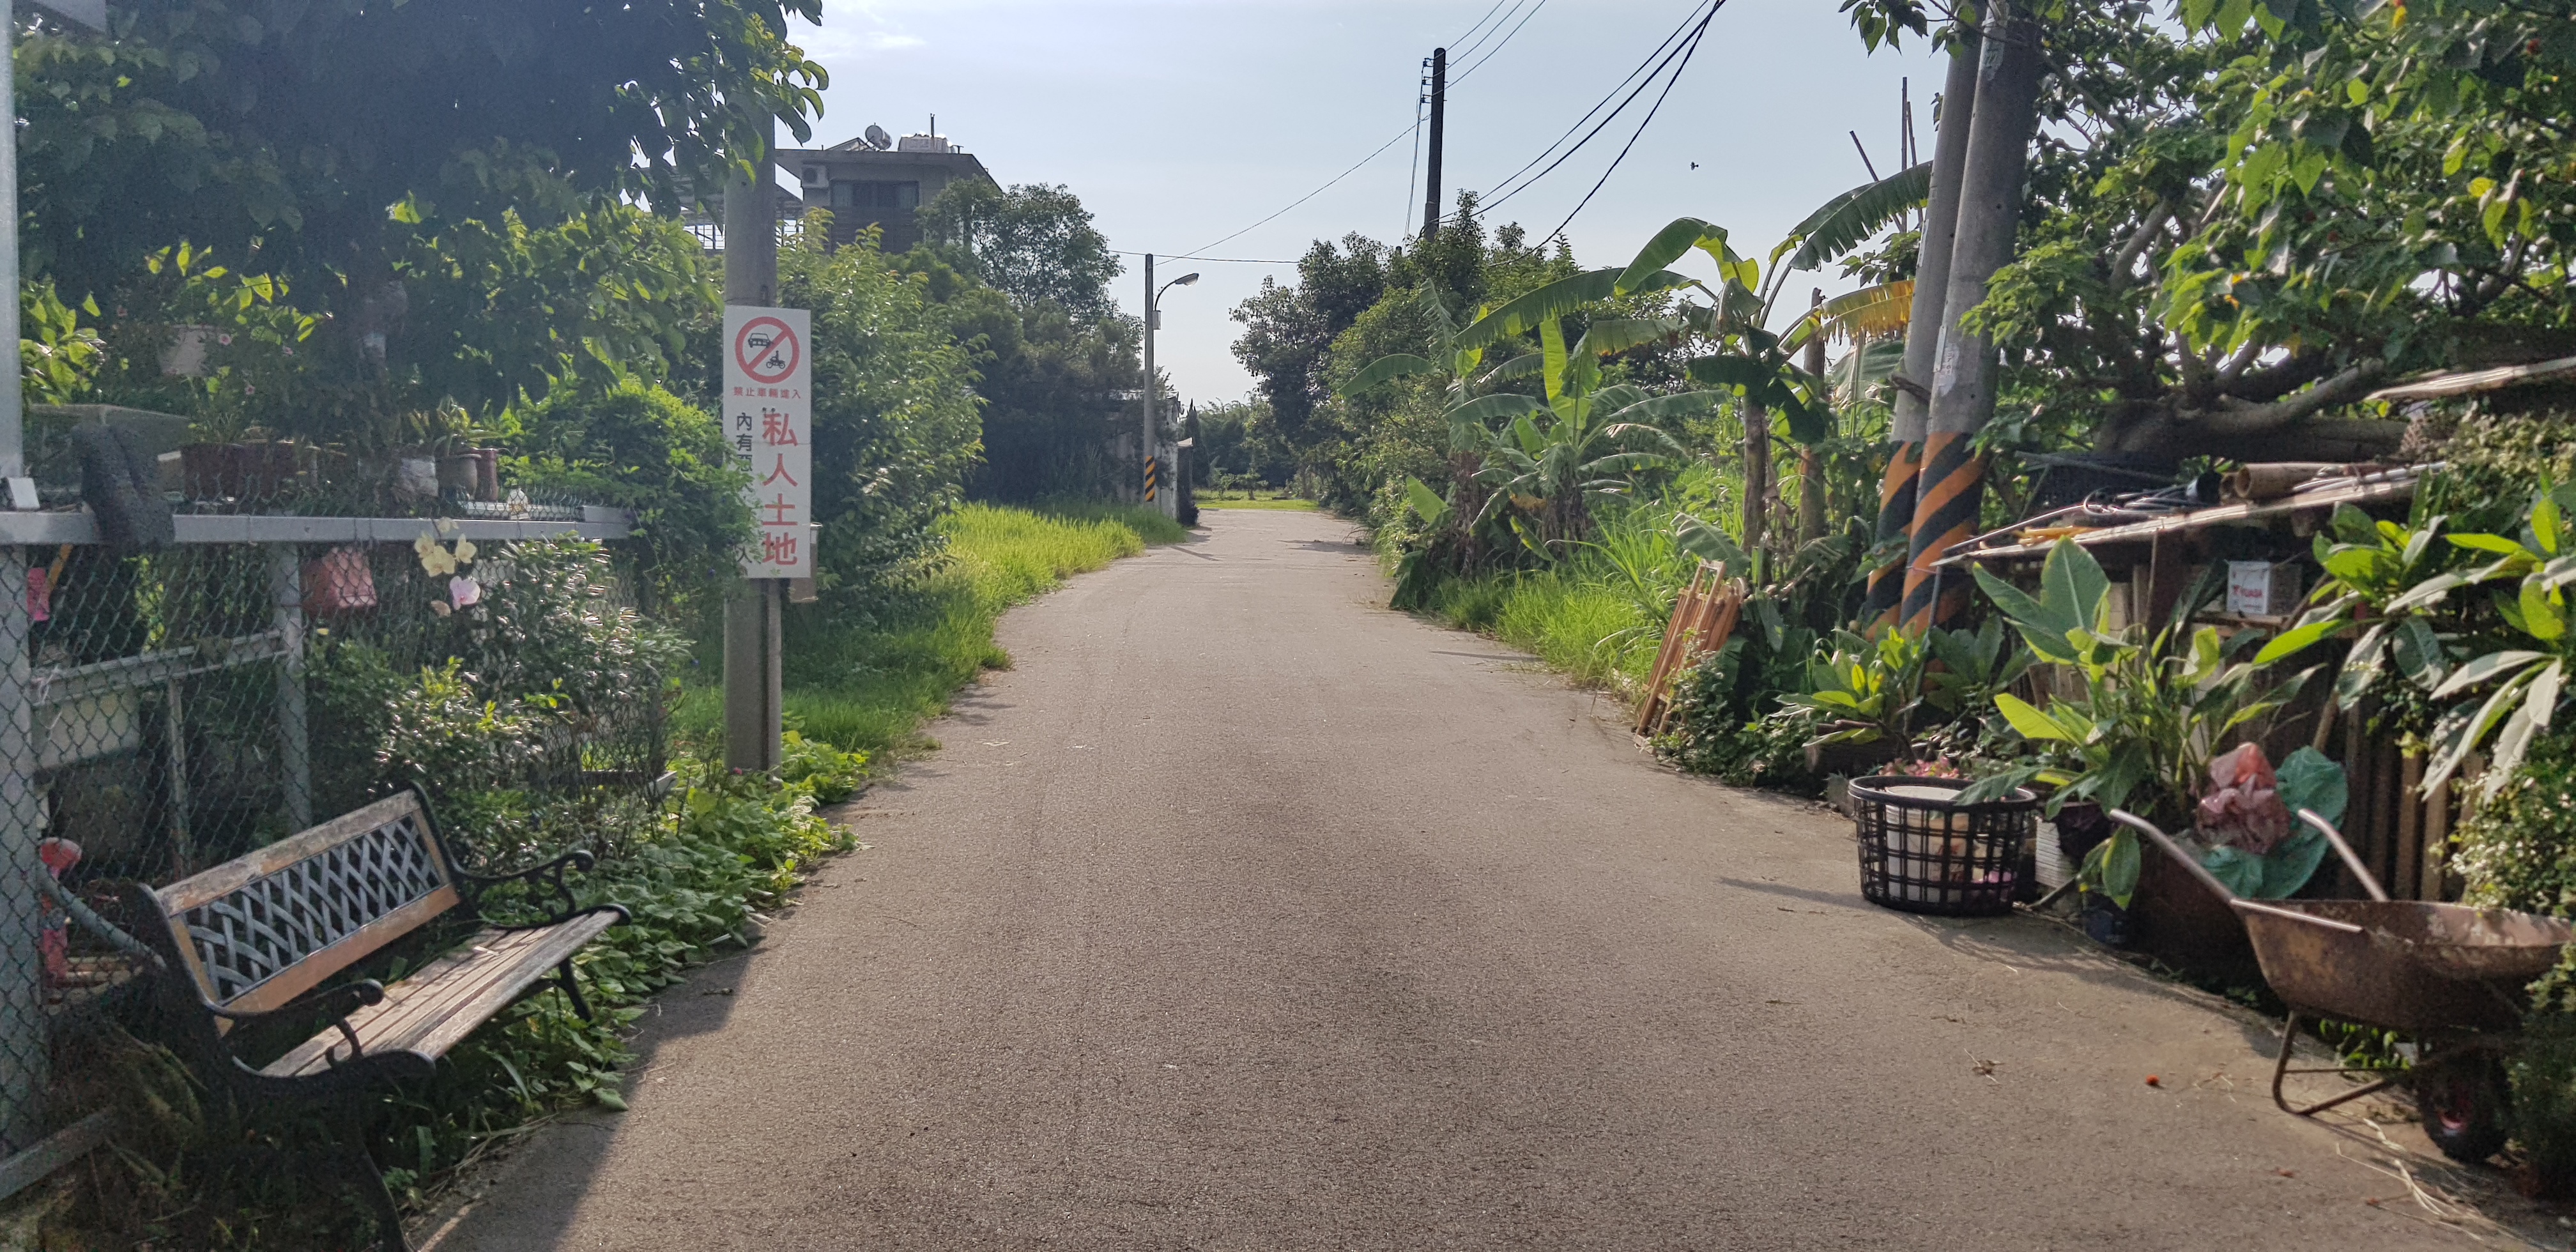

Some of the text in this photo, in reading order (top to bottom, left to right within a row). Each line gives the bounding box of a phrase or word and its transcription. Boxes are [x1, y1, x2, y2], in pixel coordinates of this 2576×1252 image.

[733, 386, 801, 399] 禁止車輛進入
[762, 413, 798, 565] 私人土地
